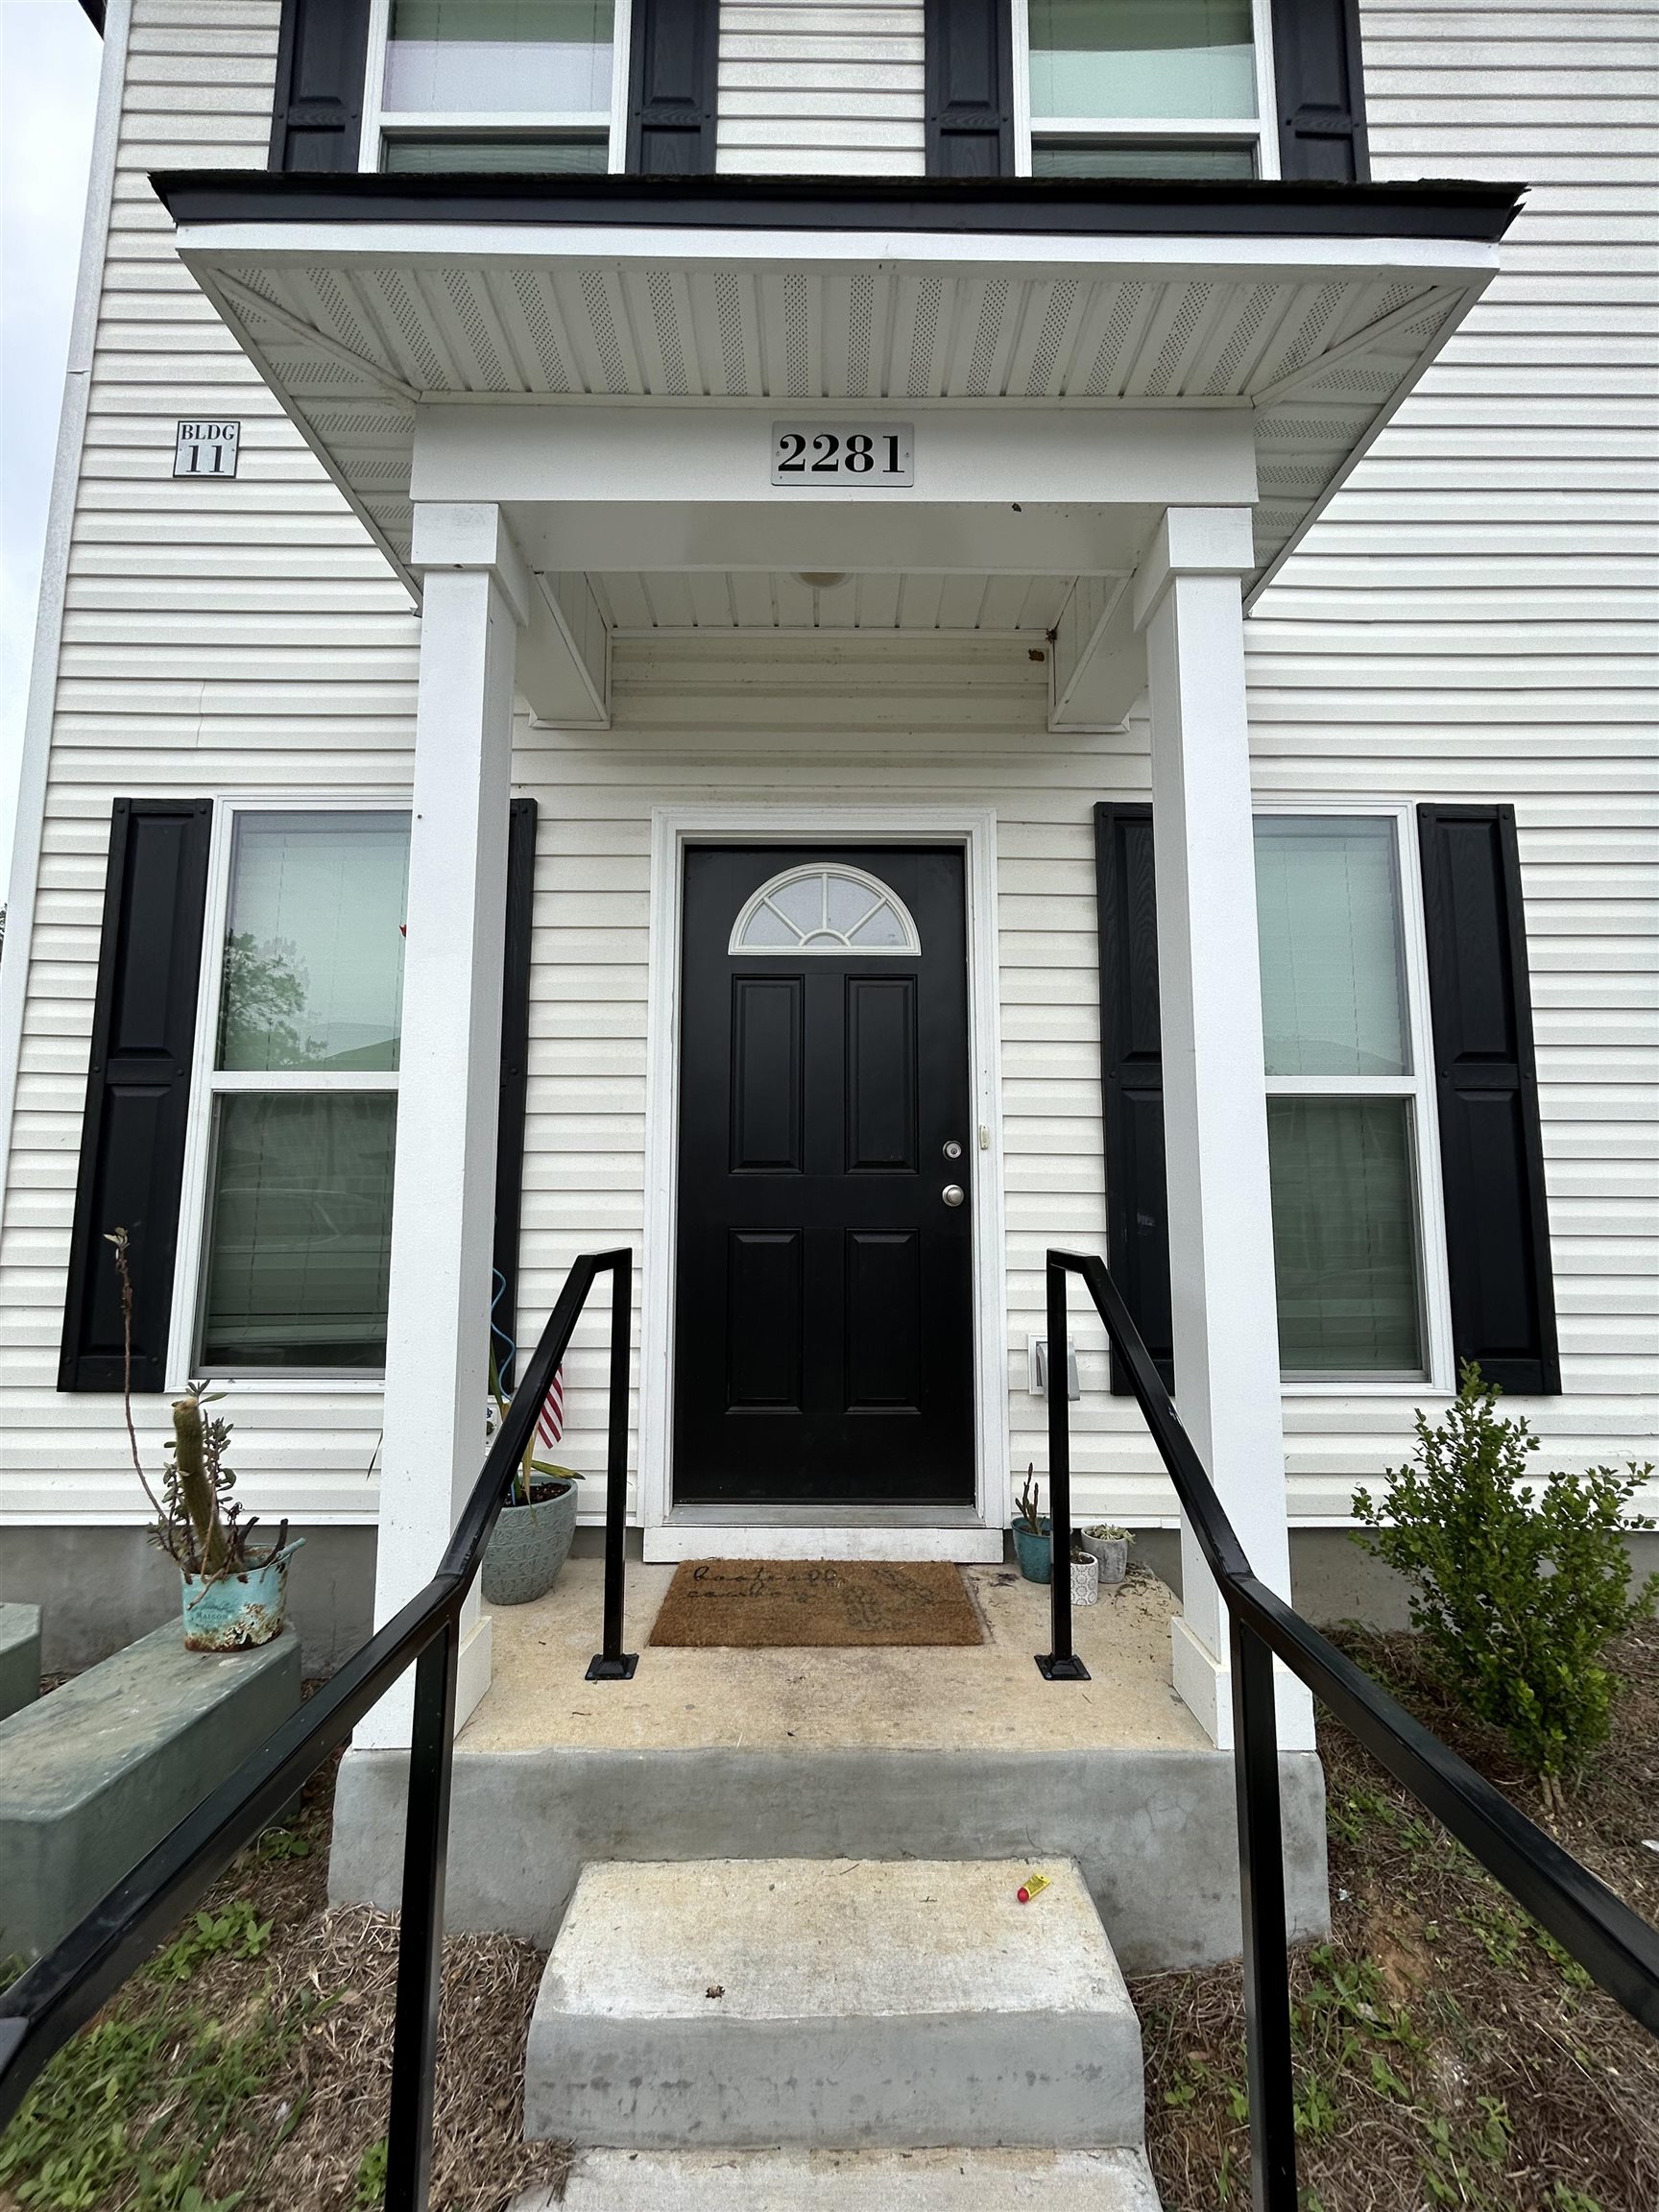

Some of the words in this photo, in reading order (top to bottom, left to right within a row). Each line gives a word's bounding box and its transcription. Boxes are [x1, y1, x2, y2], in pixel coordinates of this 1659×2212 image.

[180, 424, 235, 440] BLDG
[185, 445, 225, 473] 11
[778, 434, 905, 472] 2281
